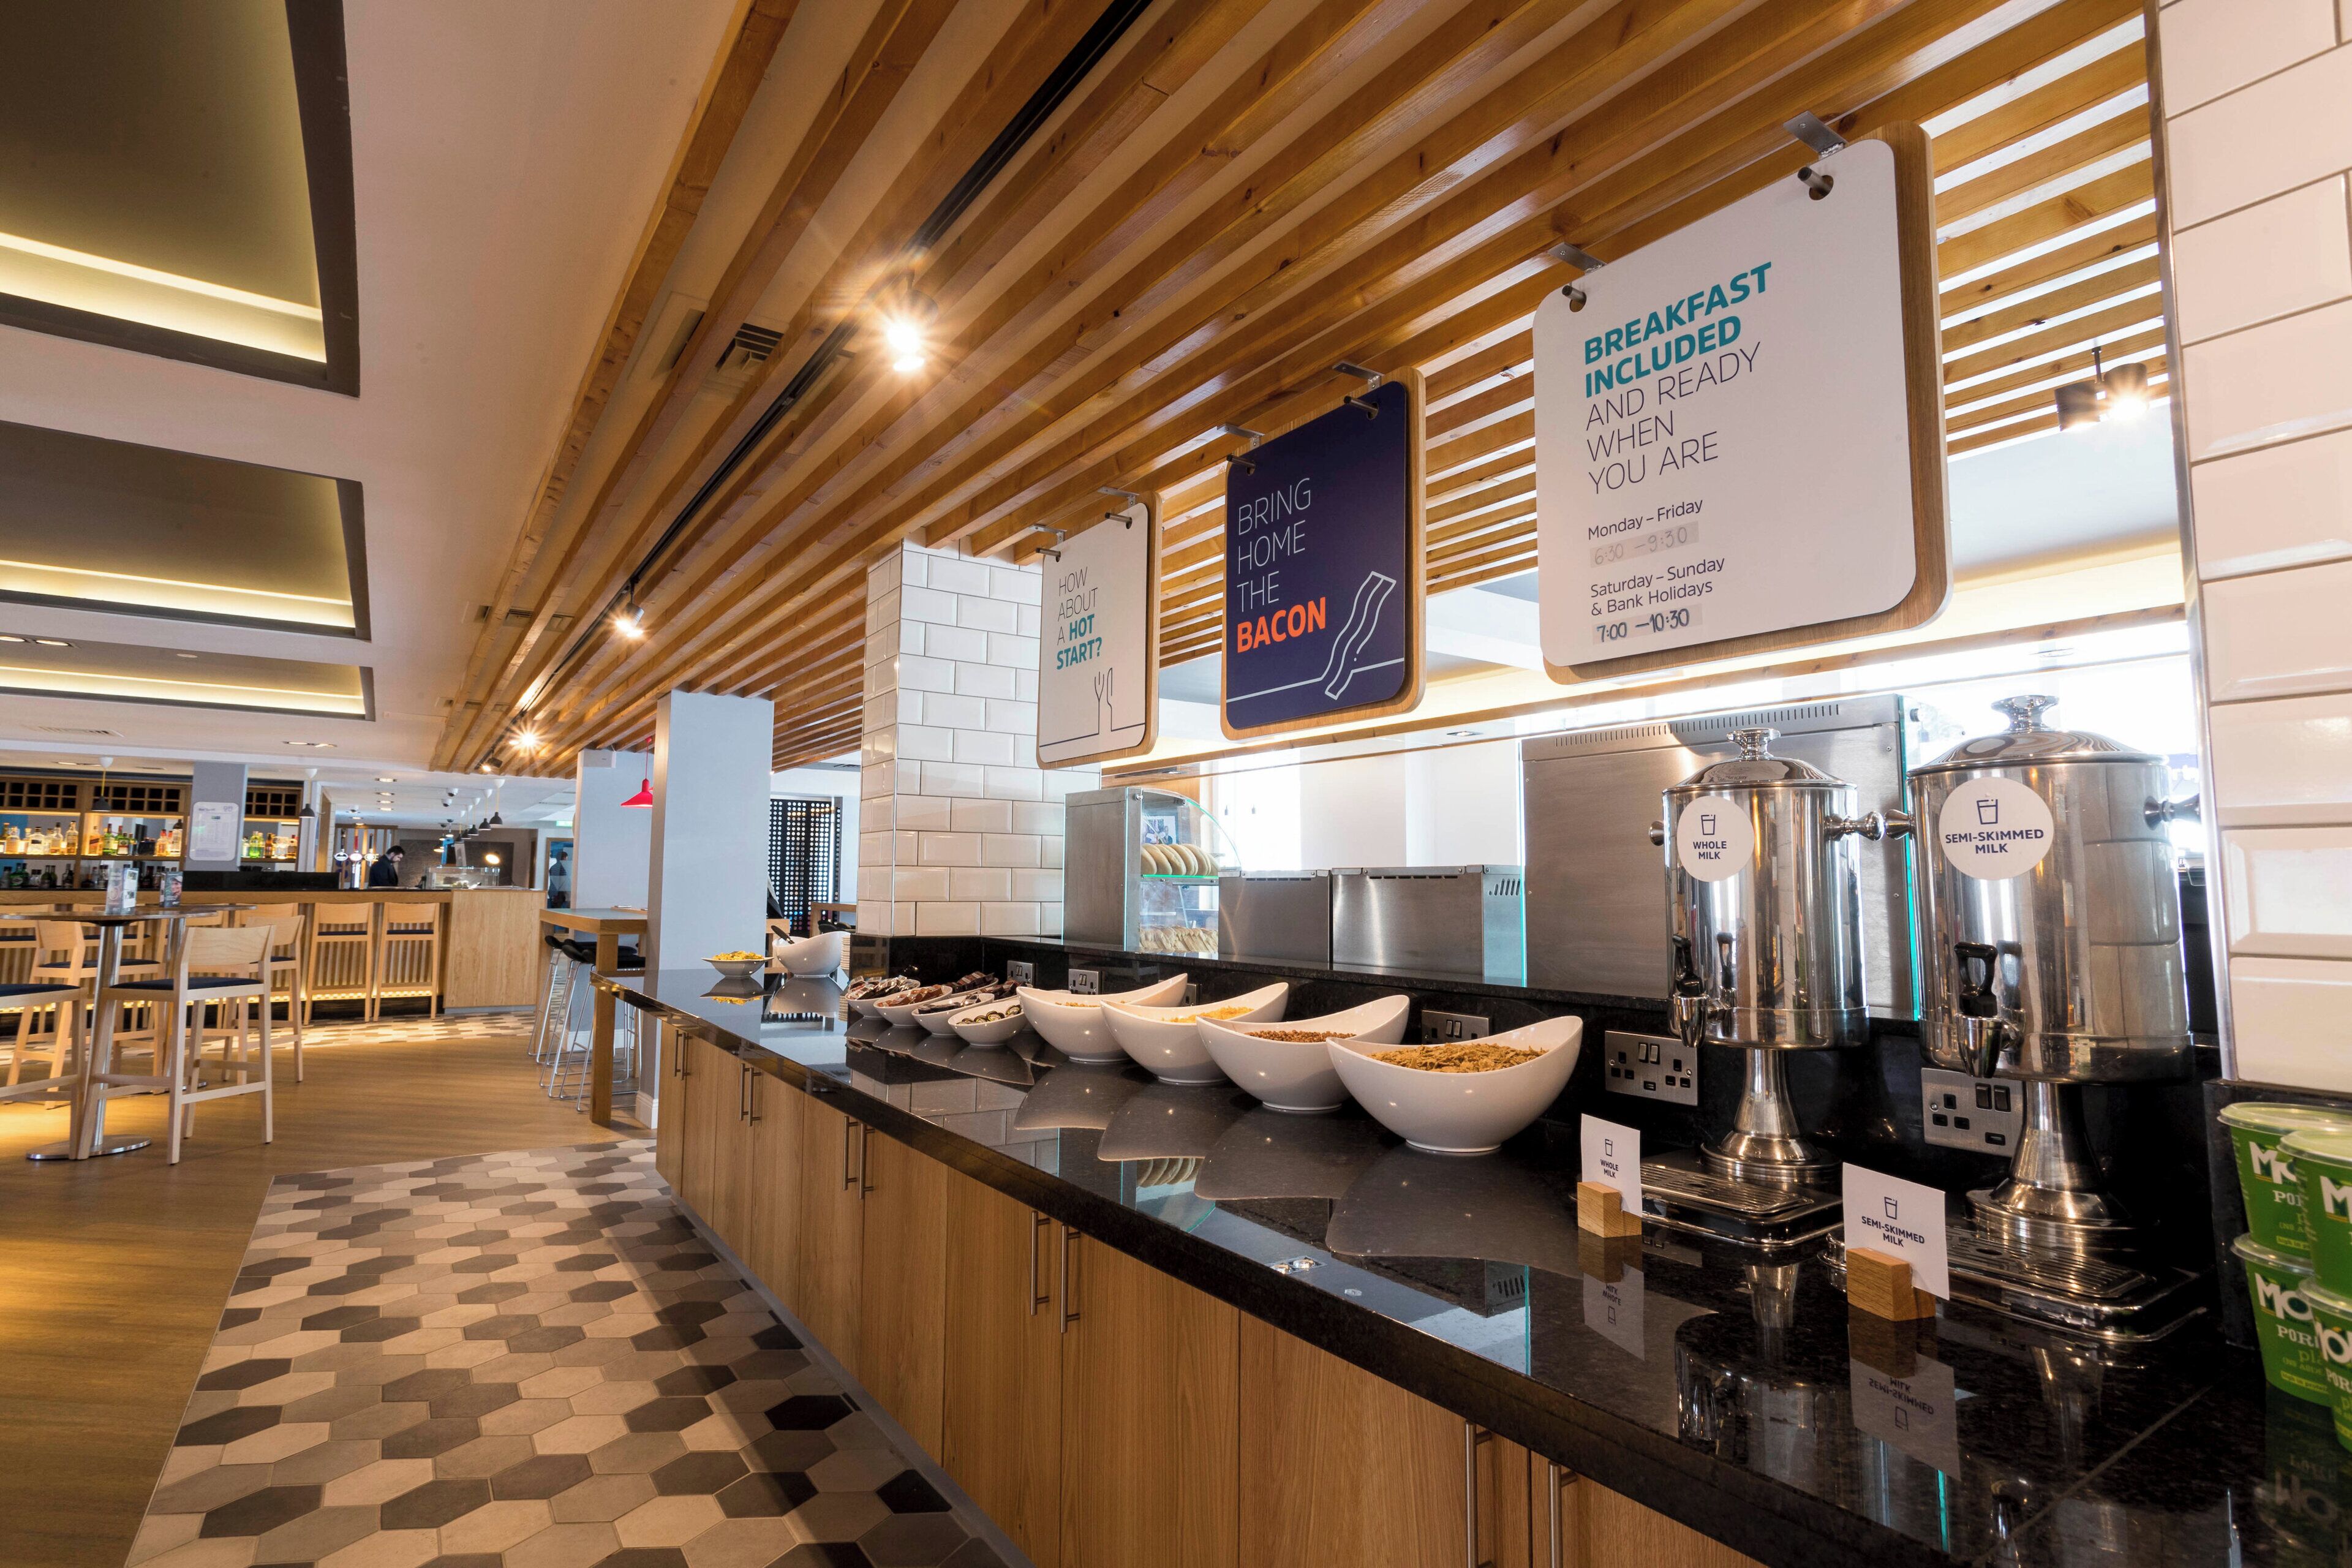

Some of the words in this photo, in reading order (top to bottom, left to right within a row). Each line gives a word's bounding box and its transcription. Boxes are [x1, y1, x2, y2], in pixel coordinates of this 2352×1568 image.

[1585, 262, 1771, 365] BREAKFAST
[1586, 315, 1741, 398] INCLUDED
[1586, 388, 1644, 431] AND
[1658, 341, 1761, 405] READY
[1586, 410, 1674, 462] WHEN
[1588, 454, 1646, 494] YOU
[1659, 431, 1718, 475] ARE
[1238, 477, 1311, 536] BRING
[1588, 516, 1643, 540] Monday
[1657, 499, 1703, 522] Friday
[1238, 519, 1306, 575] HOME
[1594, 543, 1624, 565] 6:30
[1058, 566, 1088, 597] HOW
[1237, 571, 1280, 612] THE
[1591, 573, 1653, 598] Saturday
[1667, 557, 1725, 581] Sunday
[1057, 587, 1098, 622] ABOUT
[1591, 603, 1602, 617] &
[1607, 594, 1643, 614] Bank
[1648, 581, 1713, 605] Holidays
[1057, 626, 1066, 646] A
[1069, 613, 1095, 641] HOT
[1237, 597, 1326, 654] BACON
[1596, 622, 1627, 643] 7:00
[1056, 636, 1102, 670] START?
[1693, 841, 1727, 850] WHOLE
[1945, 829, 2044, 844] SEMI-SKIMMED
[1975, 843, 2008, 854] MILK
[1698, 851, 1721, 860] MILK
[1600, 1158, 1619, 1171] WHOLE
[1604, 1168, 1616, 1179] MILK
[1861, 1216, 1925, 1244] SEMI-SKIMMED
[1883, 1232, 1904, 1248] MILK
